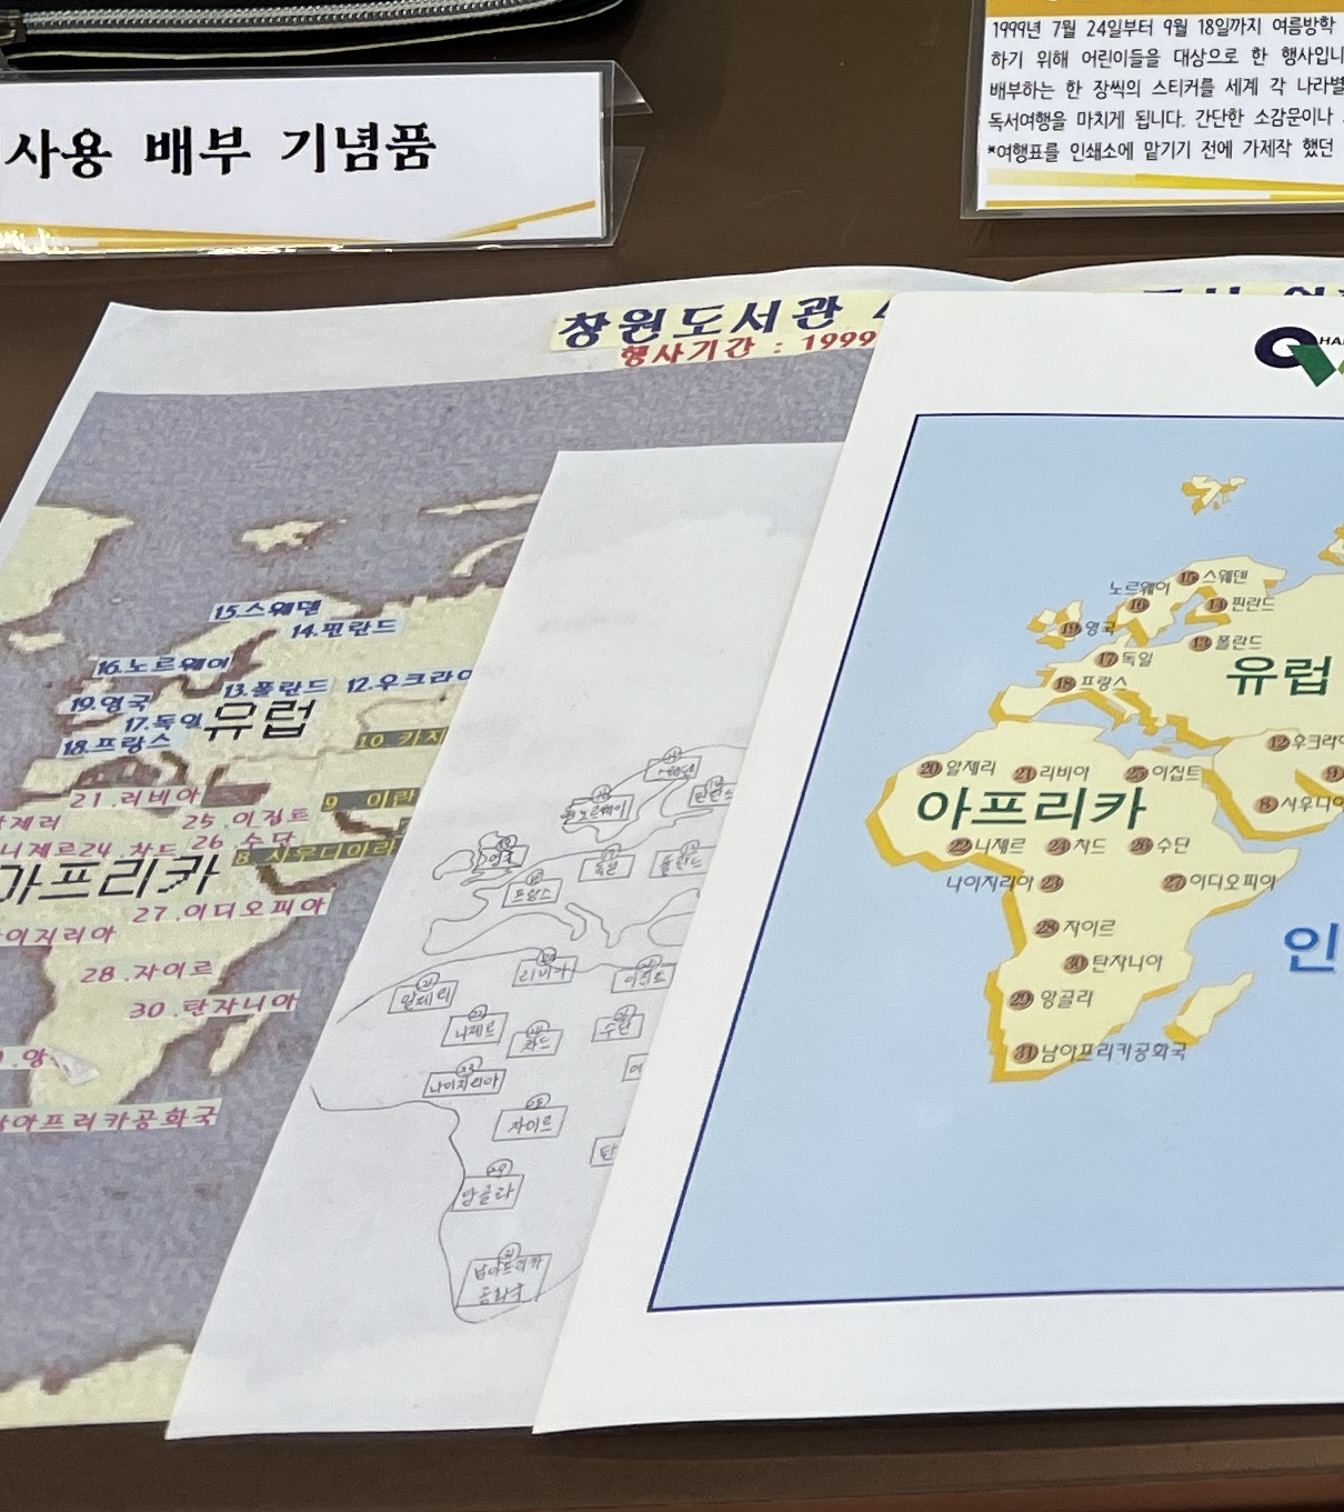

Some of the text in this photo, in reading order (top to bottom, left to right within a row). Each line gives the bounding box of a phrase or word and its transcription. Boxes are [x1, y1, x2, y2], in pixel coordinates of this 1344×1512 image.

[994, 21, 1041, 39] 1999년
[1053, 20, 1075, 39] 7월
[1087, 19, 1153, 38] 24일부터
[1164, 19, 1187, 38] 9월
[1199, 17, 1261, 36] 18일까지
[1273, 16, 1336, 36] 여름방학
[991, 51, 1022, 70] 하기
[1037, 50, 1068, 69] 위해
[1082, 49, 1161, 68] 어린이들을
[1174, 48, 1239, 68] 대상으로
[1252, 47, 1268, 66] 한
[990, 81, 1055, 100] 배부하는
[1066, 80, 1082, 99] 한
[1093, 80, 1140, 99] 장씩의
[1152, 78, 1214, 98] 스티커를
[1225, 77, 1258, 96] 세계
[1271, 78, 1286, 96] 각
[5, 121, 436, 179] 사용 배부 기념품
[1071, 141, 1133, 162] 인쇄소에
[1145, 140, 1190, 161] 맡기기
[1201, 139, 1232, 160] 전에
[1243, 139, 1292, 158] 가제작
[1303, 138, 1333, 158] 했던
[559, 294, 842, 349] 창원도서관
[1203, 569, 1249, 586] 스웨덴
[1232, 596, 1276, 613] 핀란드
[291, 619, 398, 640] 14.핀란드
[1121, 651, 1153, 668] 독일
[1227, 656, 1333, 696] 유럽
[204, 699, 316, 741] 유럽
[62, 734, 172, 757] 18.프랑스
[946, 759, 998, 777] 알제리
[1039, 764, 1090, 781] 리비아
[1152, 765, 1202, 783] 이집트
[917, 787, 1148, 831] 아프리카
[1157, 838, 1191, 855] 수단
[1041, 990, 1094, 1009] 앙골라
